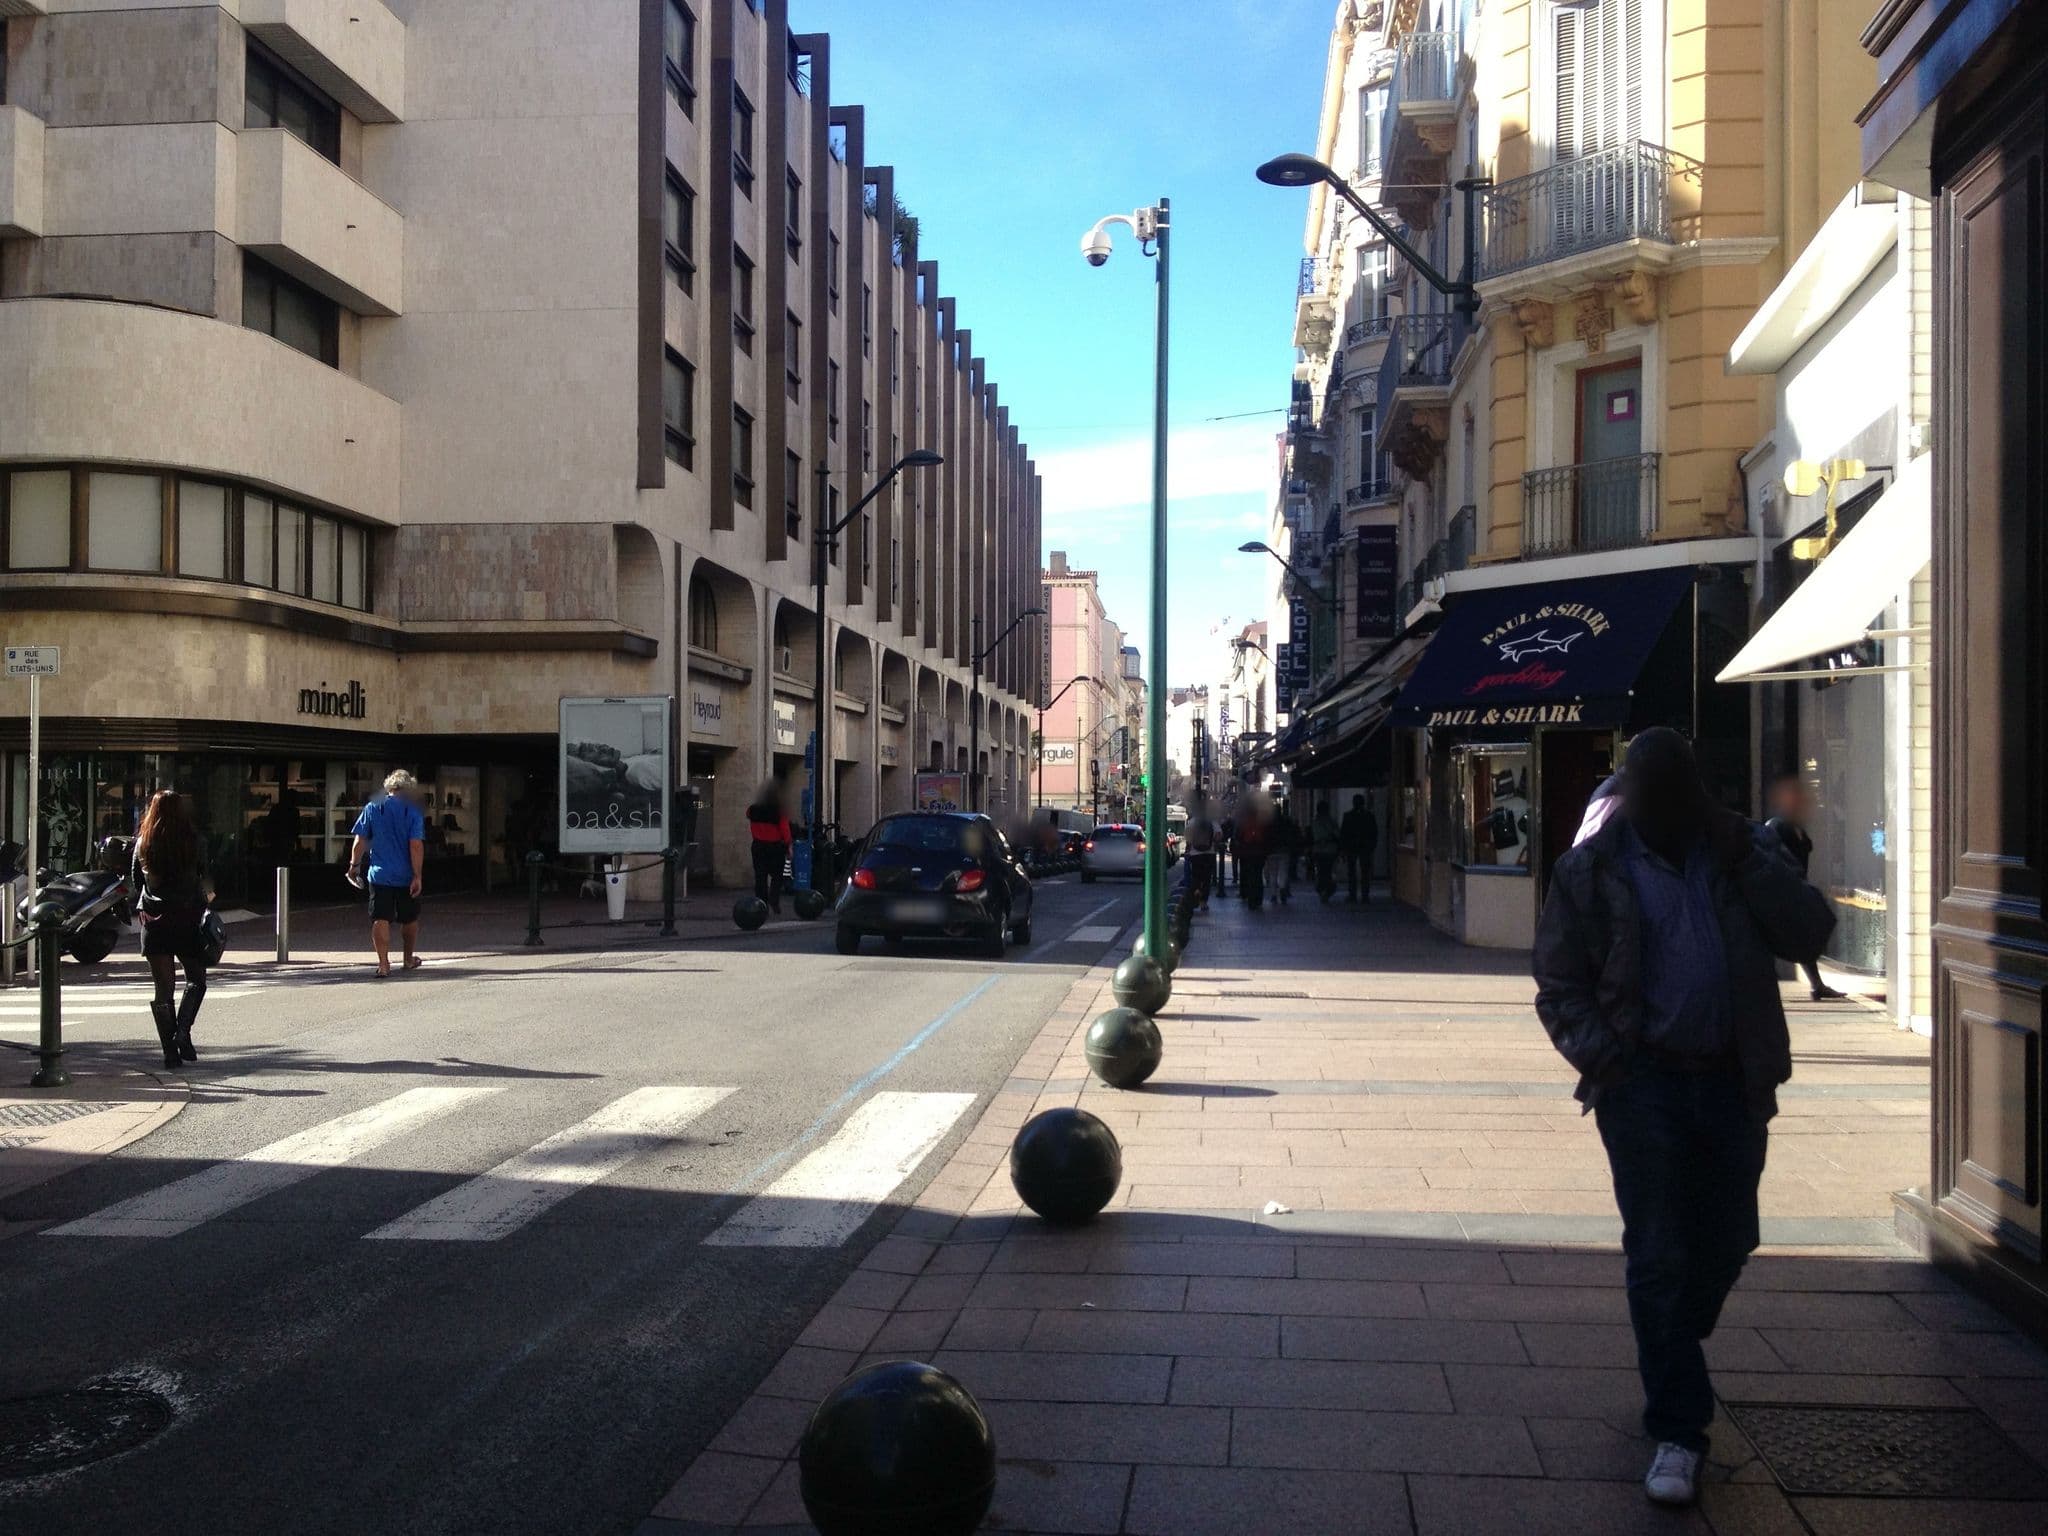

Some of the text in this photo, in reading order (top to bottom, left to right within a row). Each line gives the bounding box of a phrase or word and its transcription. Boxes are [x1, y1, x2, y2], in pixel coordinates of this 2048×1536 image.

[1294, 602, 1307, 670] HOTEL
[1481, 603, 1610, 646] PAUL & SHARK
[297, 680, 366, 719] minelli
[1278, 645, 1290, 711] HOTEL
[1426, 704, 1584, 727] PAUL & SHARK
